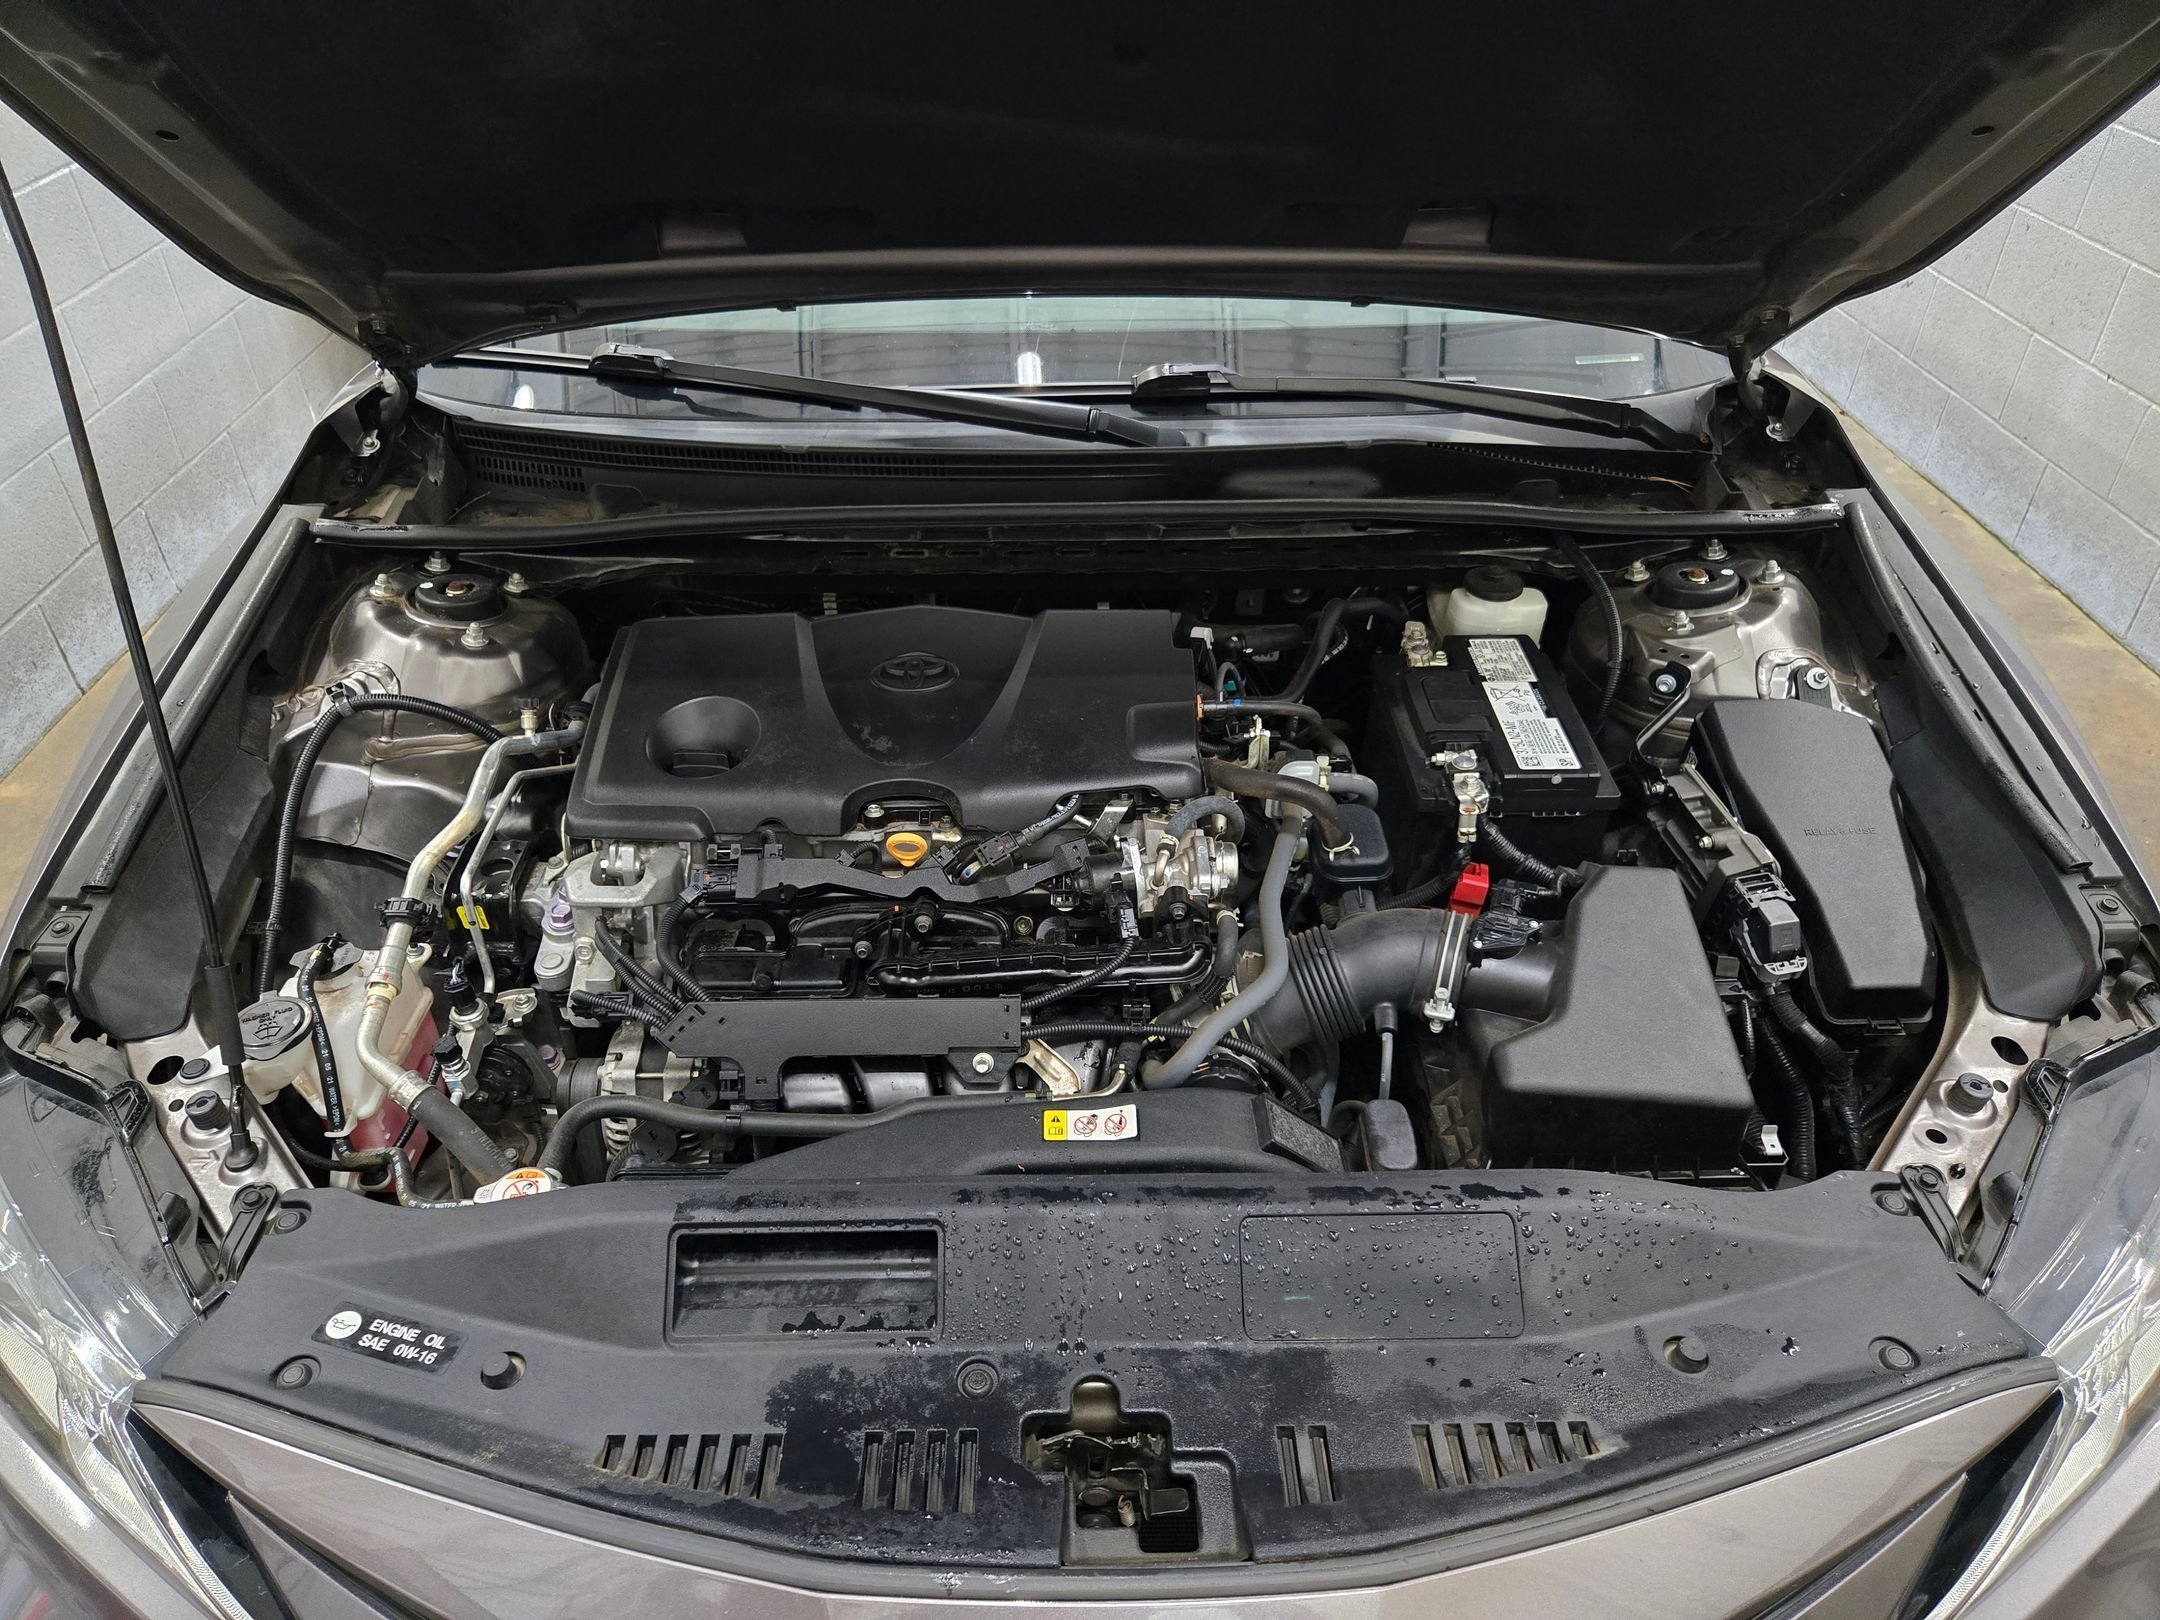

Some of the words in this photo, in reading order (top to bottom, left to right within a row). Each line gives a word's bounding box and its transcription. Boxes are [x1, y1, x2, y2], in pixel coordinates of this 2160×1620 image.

[1803, 826, 1838, 836] RELAY
[1848, 826, 1878, 835] FUSE
[328, 1086, 338, 1105] WATER
[369, 1318, 421, 1342] ENGINE
[423, 1333, 446, 1350] OIL
[358, 1334, 390, 1352] SAE
[393, 1343, 438, 1365] 0W-16
